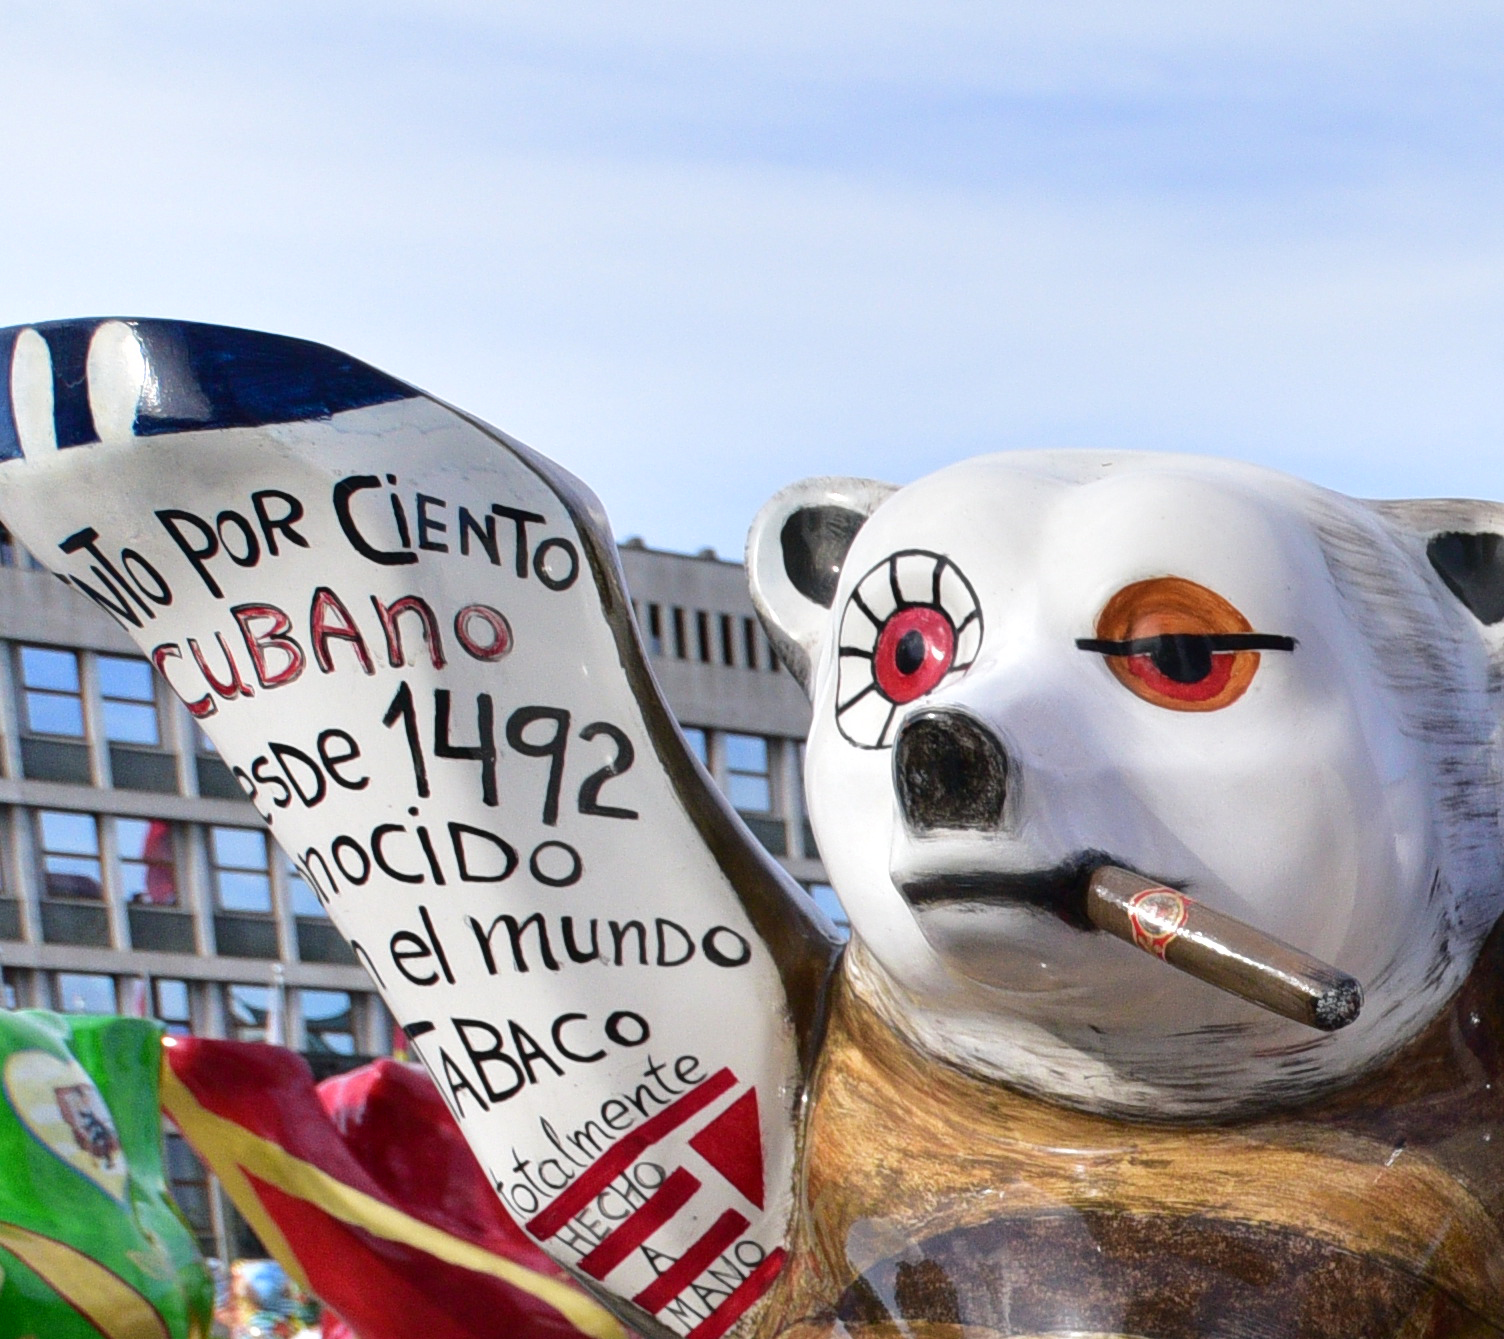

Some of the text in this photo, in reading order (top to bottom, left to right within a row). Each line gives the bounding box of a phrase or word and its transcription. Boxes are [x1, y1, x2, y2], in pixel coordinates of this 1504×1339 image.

[154, 489, 310, 598] POR
[383, 681, 639, 826] 1492
[390, 906, 455, 985] el
[551, 1162, 667, 1257] HECHO
[640, 1245, 678, 1277] A
[666, 1240, 766, 1331] MANO
